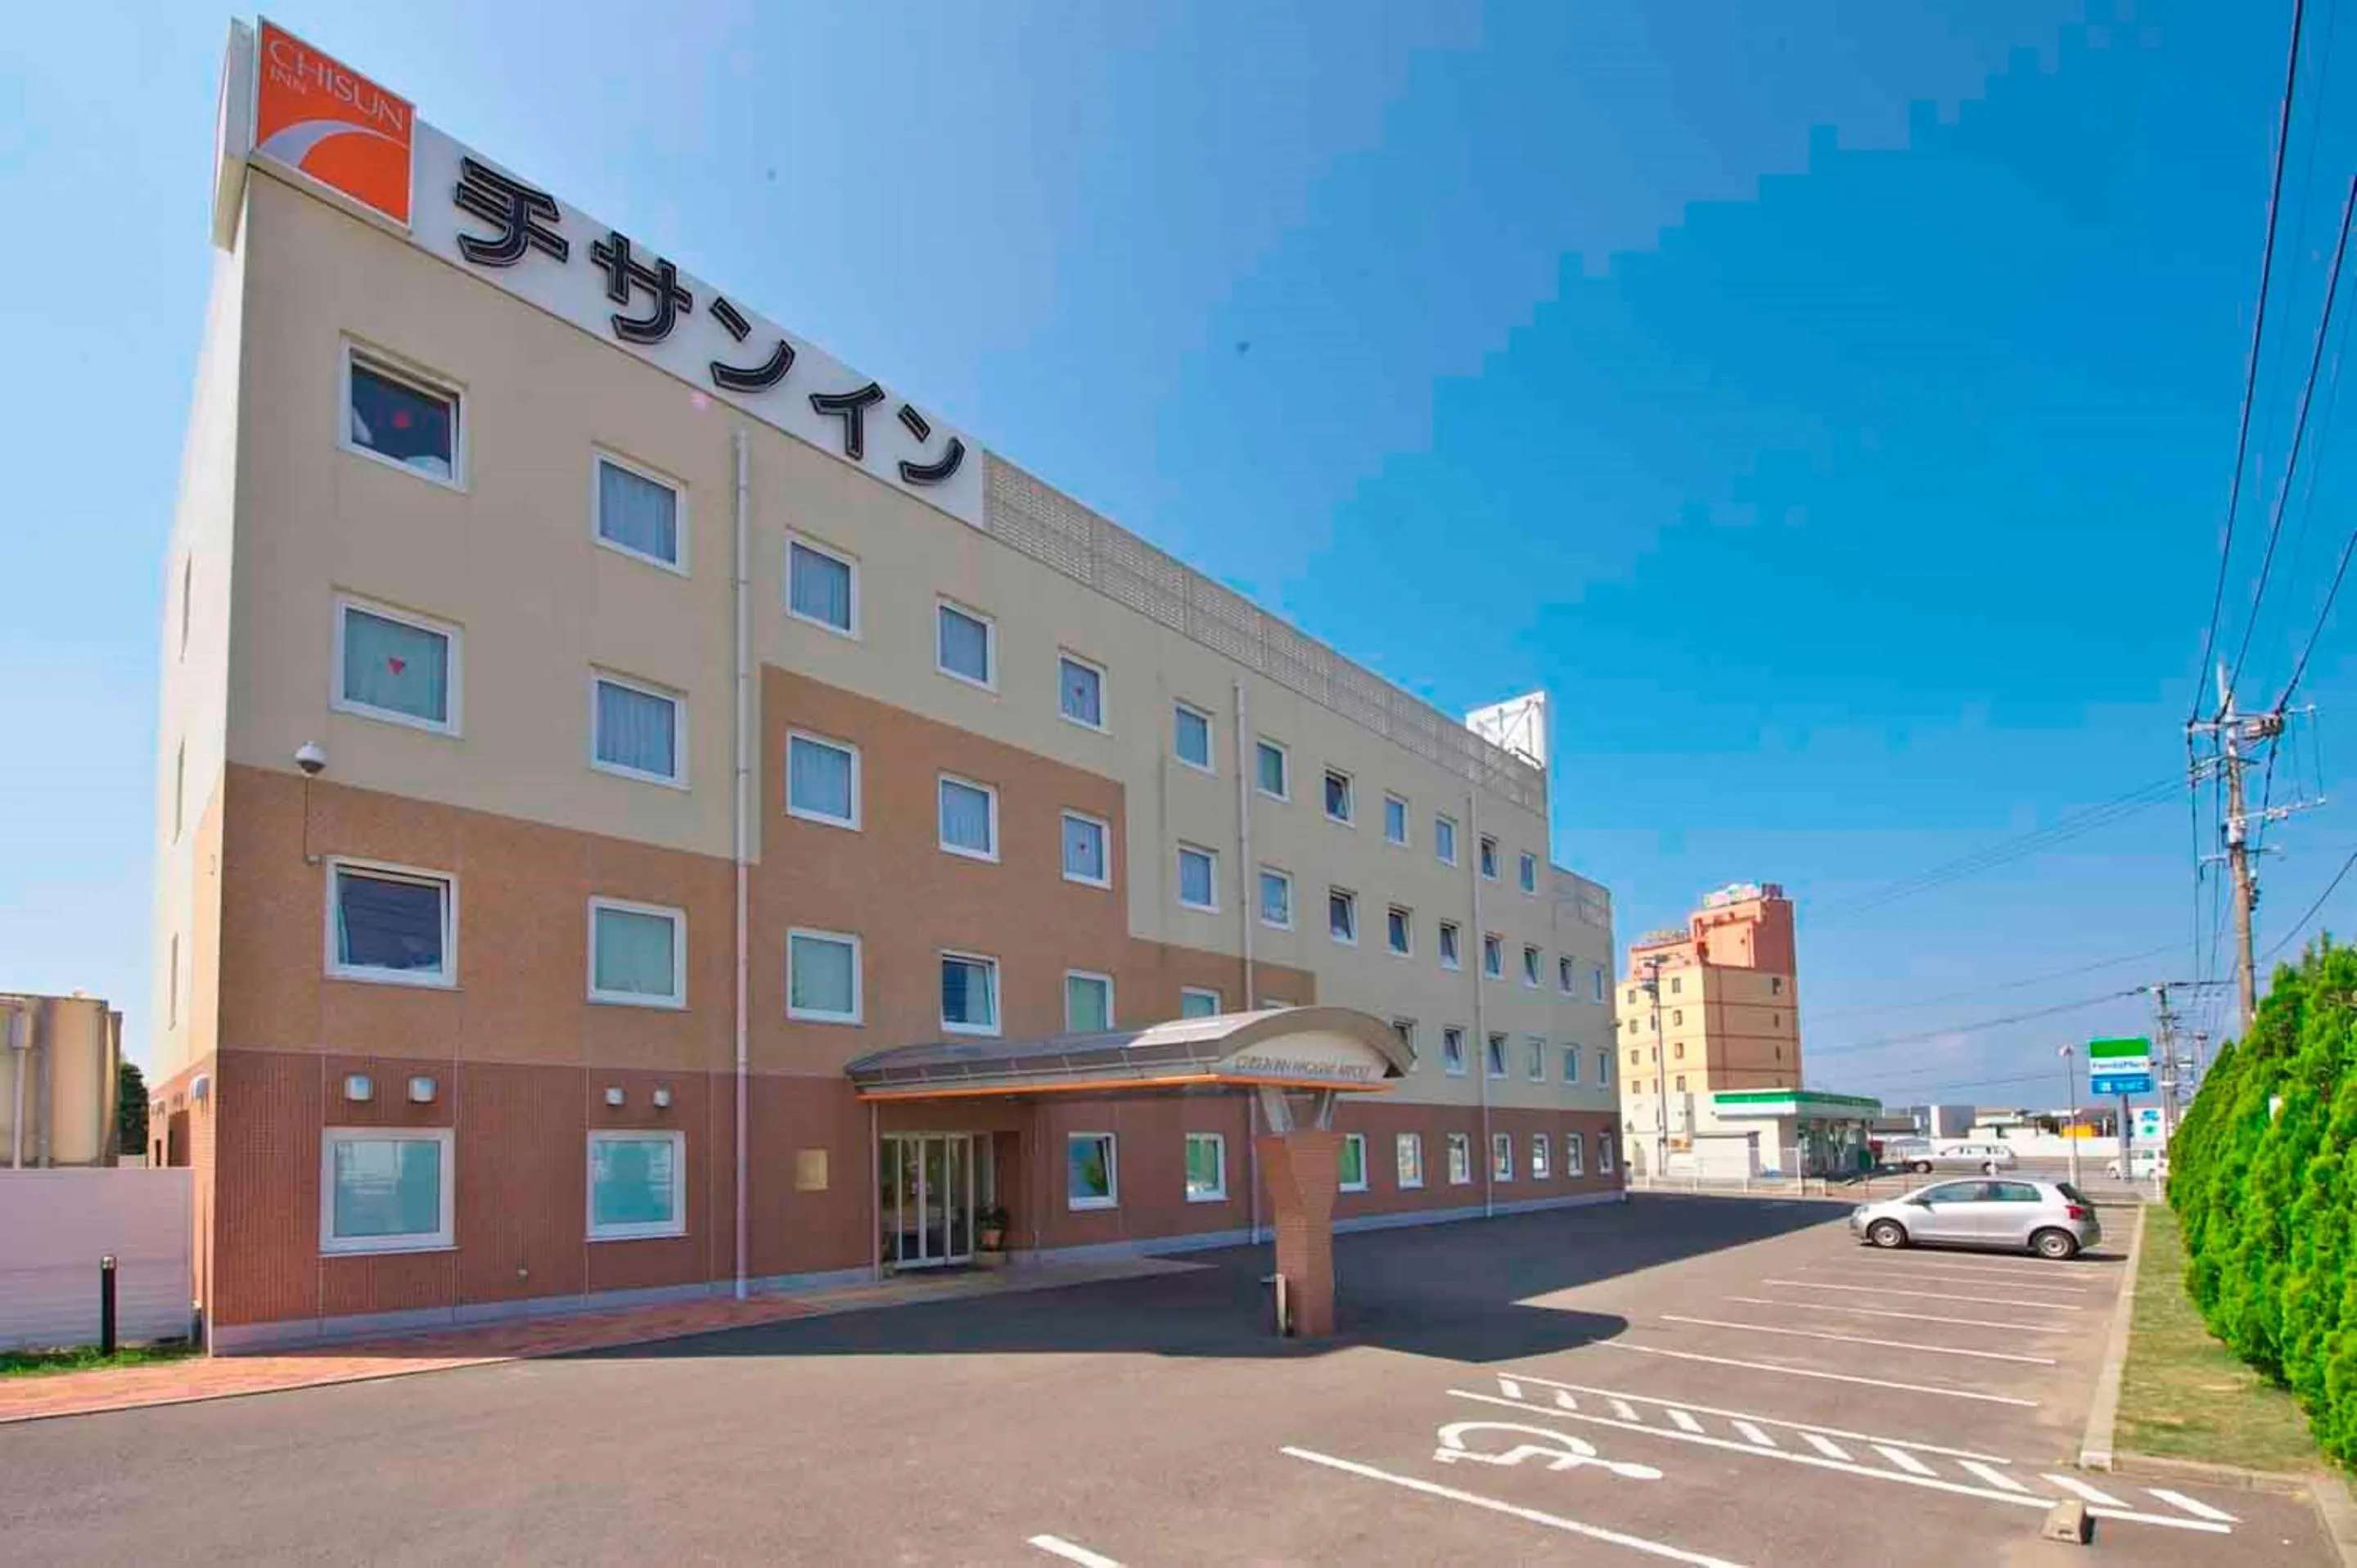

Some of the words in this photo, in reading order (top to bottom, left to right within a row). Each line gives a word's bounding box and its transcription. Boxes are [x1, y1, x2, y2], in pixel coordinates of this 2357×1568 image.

[268, 39, 403, 131] CHISUN
[269, 64, 307, 95] INN
[453, 155, 966, 486] チサンイン
